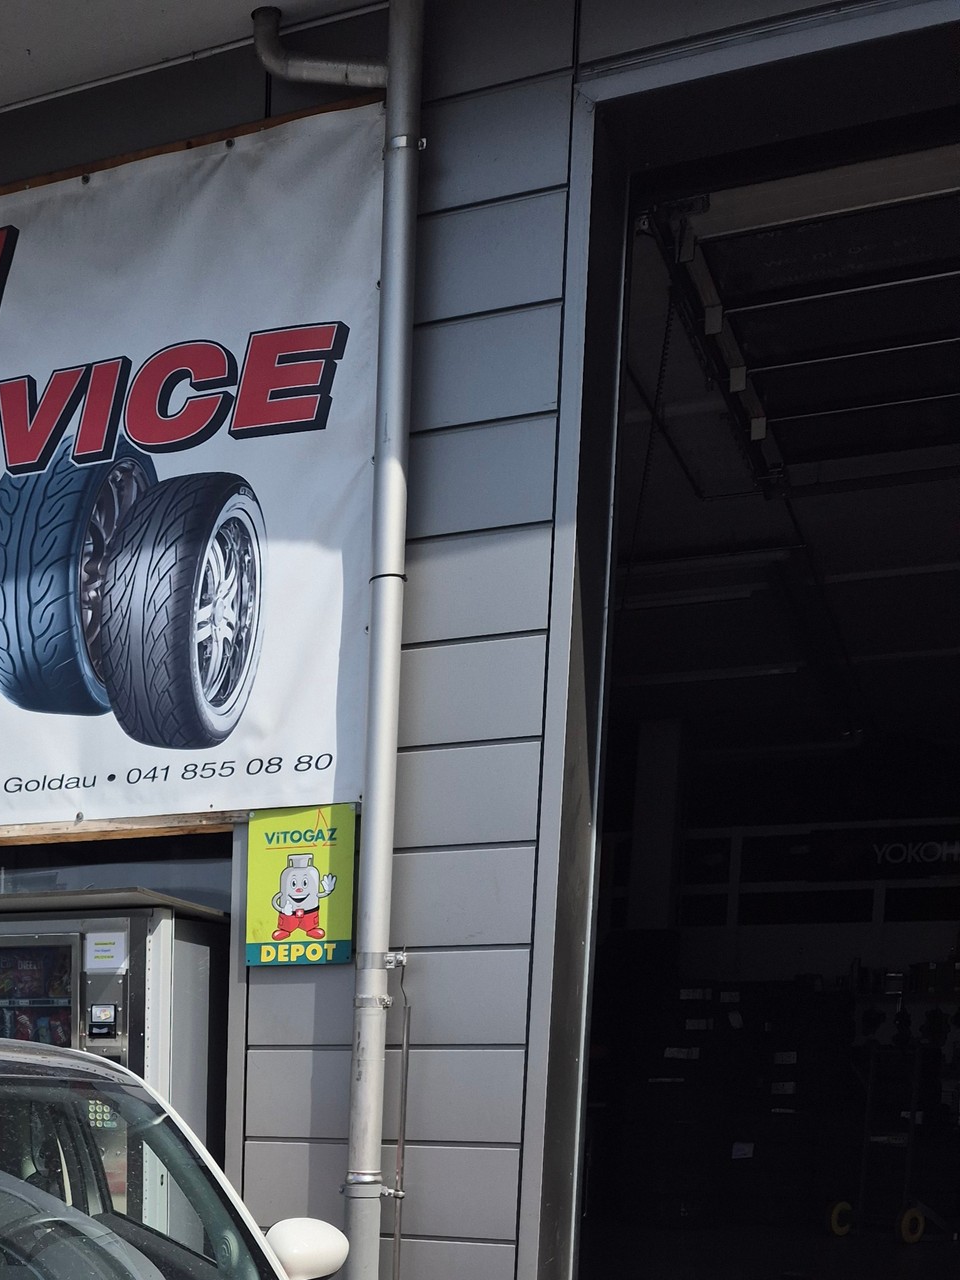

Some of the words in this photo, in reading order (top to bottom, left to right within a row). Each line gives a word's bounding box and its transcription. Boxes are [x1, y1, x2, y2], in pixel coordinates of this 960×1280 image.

[3, 773, 97, 794] Goldau
[126, 764, 171, 785] 041
[180, 760, 236, 781] 855
[245, 756, 283, 776] 08
[293, 752, 334, 772] 80
[260, 942, 337, 963] DEPOT
